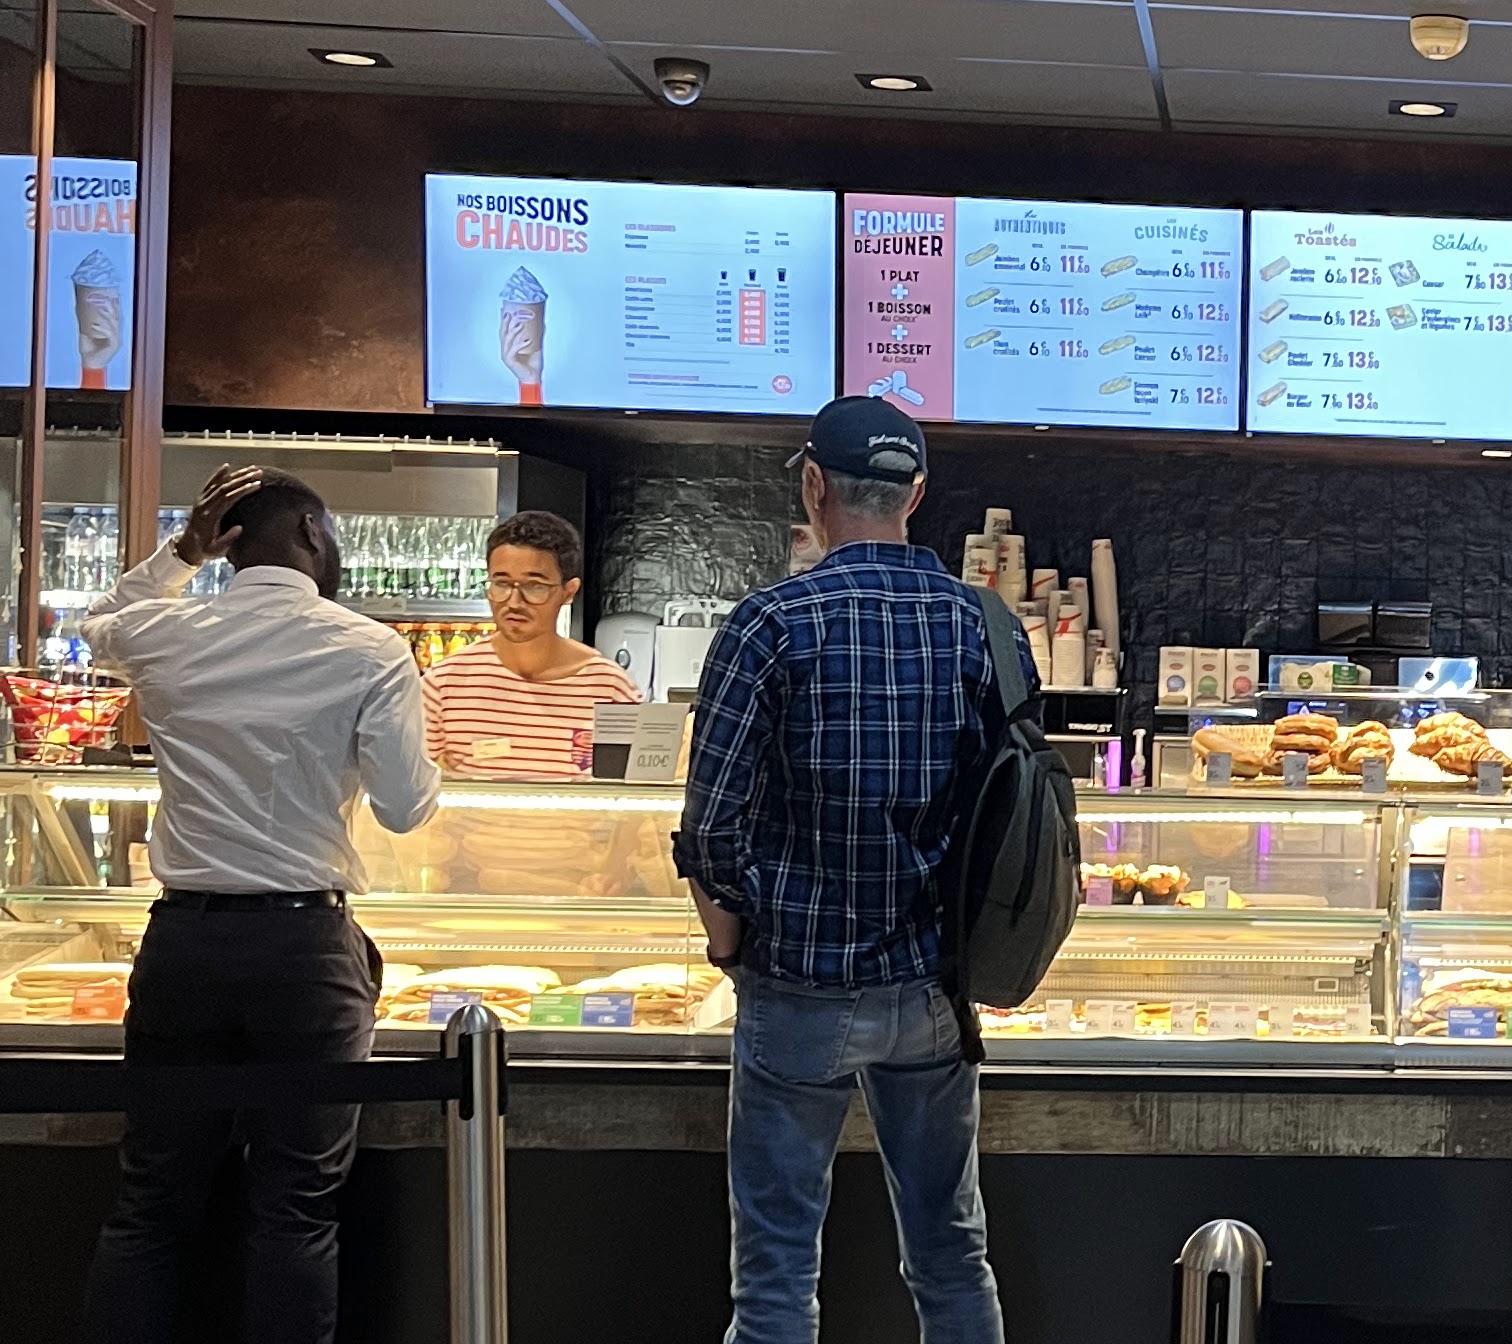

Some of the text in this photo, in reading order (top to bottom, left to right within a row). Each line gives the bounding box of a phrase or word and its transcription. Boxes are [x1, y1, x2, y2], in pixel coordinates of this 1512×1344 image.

[457, 194, 589, 226] NOS BOISSONS
[853, 209, 945, 236] FORMULE
[994, 219, 1066, 235] AUTHENTIQUES
[456, 210, 588, 253] CHAUDES
[1134, 224, 1209, 243] CUISINÉS
[854, 235, 943, 257] DÉJEUNER
[1294, 234, 1356, 248] Toastés
[880, 270, 919, 282] 1 PLAT
[868, 302, 931, 315] 1 BOISSON
[867, 342, 931, 355] 1 DESSERT
